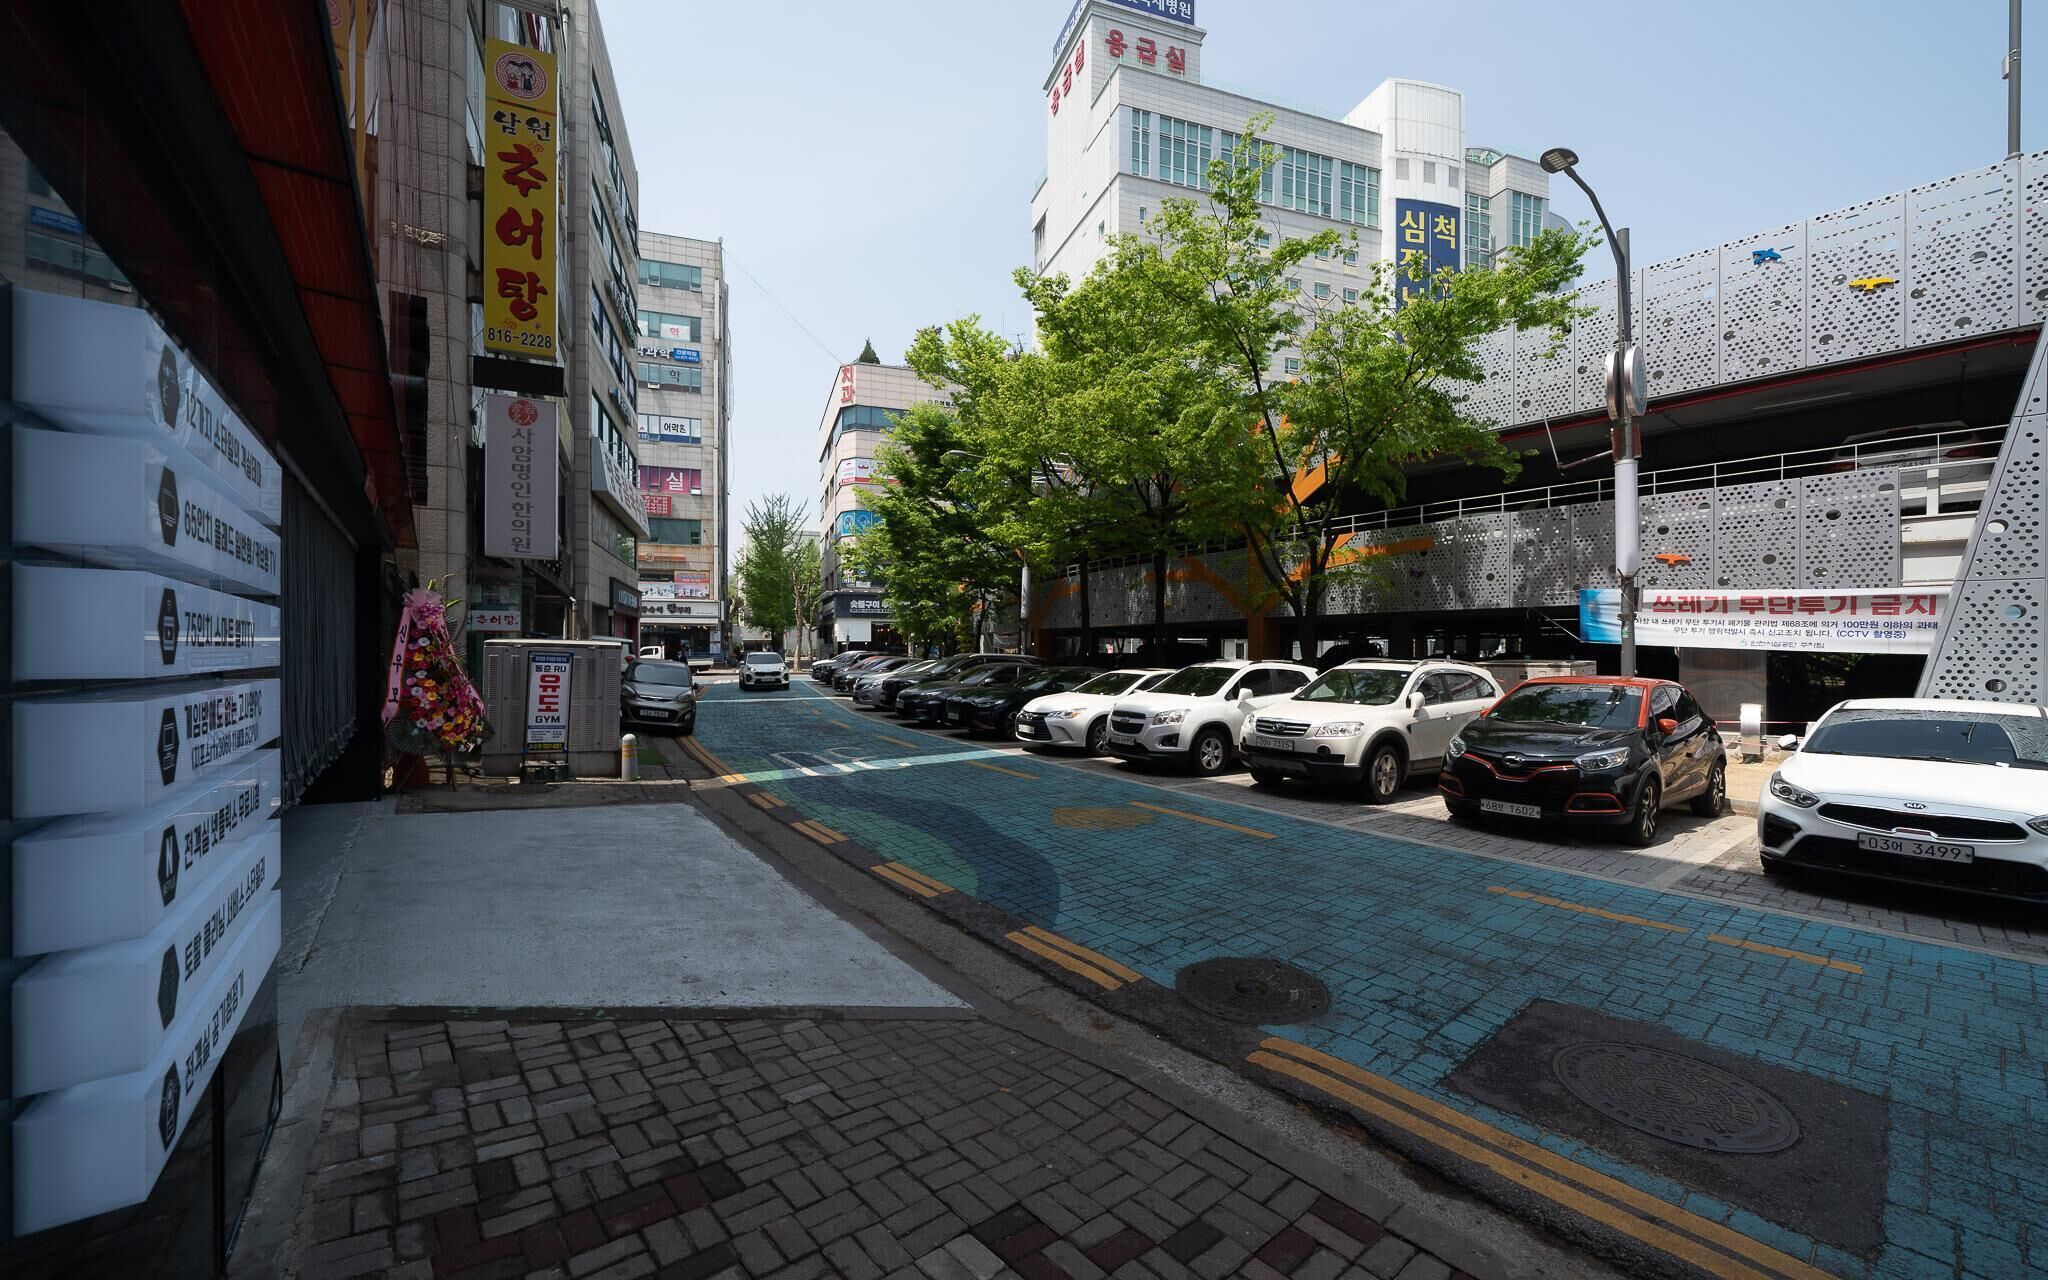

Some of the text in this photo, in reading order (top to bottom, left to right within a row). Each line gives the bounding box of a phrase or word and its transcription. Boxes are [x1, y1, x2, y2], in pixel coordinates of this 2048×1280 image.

[1105, 29, 1186, 73] 응급실
[1051, 40, 1085, 117] 응급실
[493, 110, 552, 142] 남원
[496, 143, 548, 322] 추어탕
[487, 328, 552, 348] 816-2228
[841, 366, 855, 403] 치과
[185, 388, 212, 443] 12가지
[214, 418, 240, 469] 스타일의
[511, 428, 534, 554] 사암명인한의원
[666, 472, 683, 491] 실
[185, 501, 213, 545] 65인치
[214, 518, 234, 556] 올레드
[851, 600, 880, 609] 숯불구이
[1653, 594, 1937, 615] 쓰레기 무단투기 금지
[185, 612, 212, 647] 75인치
[215, 616, 234, 647] 스마트
[1691, 627, 1706, 635] 투기
[1805, 629, 1833, 637] 됩니다.
[1836, 630, 1869, 638] (CCTV
[1874, 630, 1907, 638] 촬영중)
[1781, 620, 1818, 628] 제68조에
[1821, 620, 1838, 628] 의거
[1843, 621, 1879, 629] 100만원
[1883, 621, 1913, 629] 이하의
[1917, 621, 1938, 630] 과태
[225, 696, 237, 727] 없는
[535, 715, 560, 723] GYM
[185, 783, 260, 870] 전객실 넷플릭스 무료시청
[1511, 804, 1535, 816] 1602
[1912, 842, 1962, 859] 3499
[204, 904, 225, 958] 클리닝
[227, 882, 244, 928] 서비스
[185, 968, 244, 1096] 전객실 공기청정기
